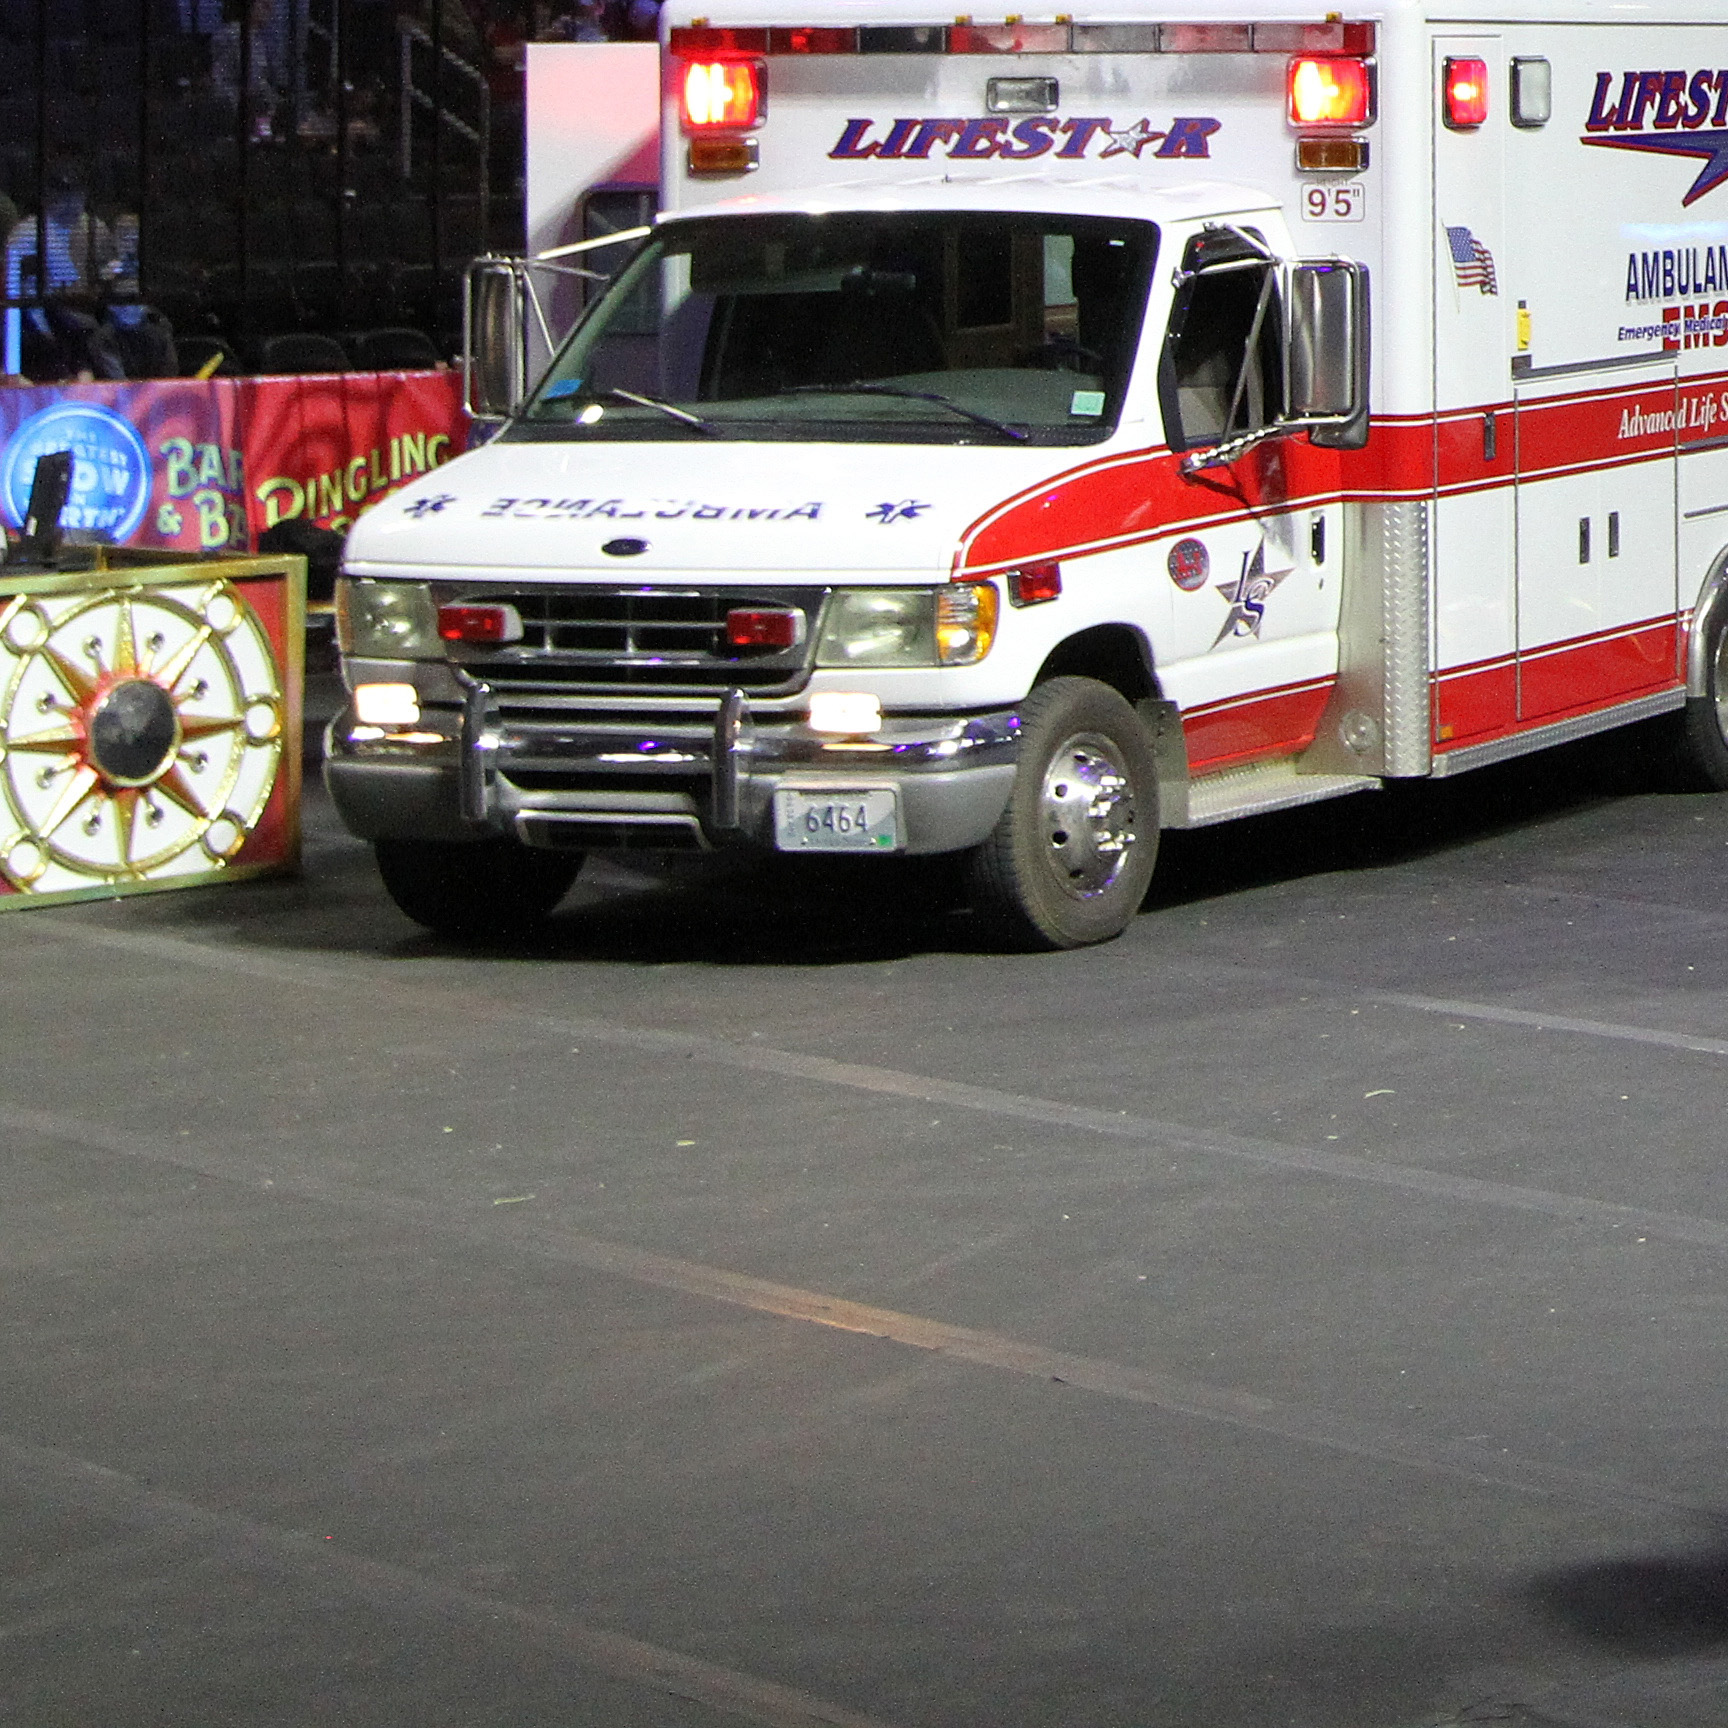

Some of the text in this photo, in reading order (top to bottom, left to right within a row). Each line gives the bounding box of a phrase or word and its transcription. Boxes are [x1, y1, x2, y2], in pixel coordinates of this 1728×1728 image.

[1617, 321, 1681, 342] Emergency
[1683, 315, 1728, 334] Medical
[1617, 396, 1688, 440] Advanced
[1689, 391, 1719, 432] Life
[805, 802, 869, 833] 6464
